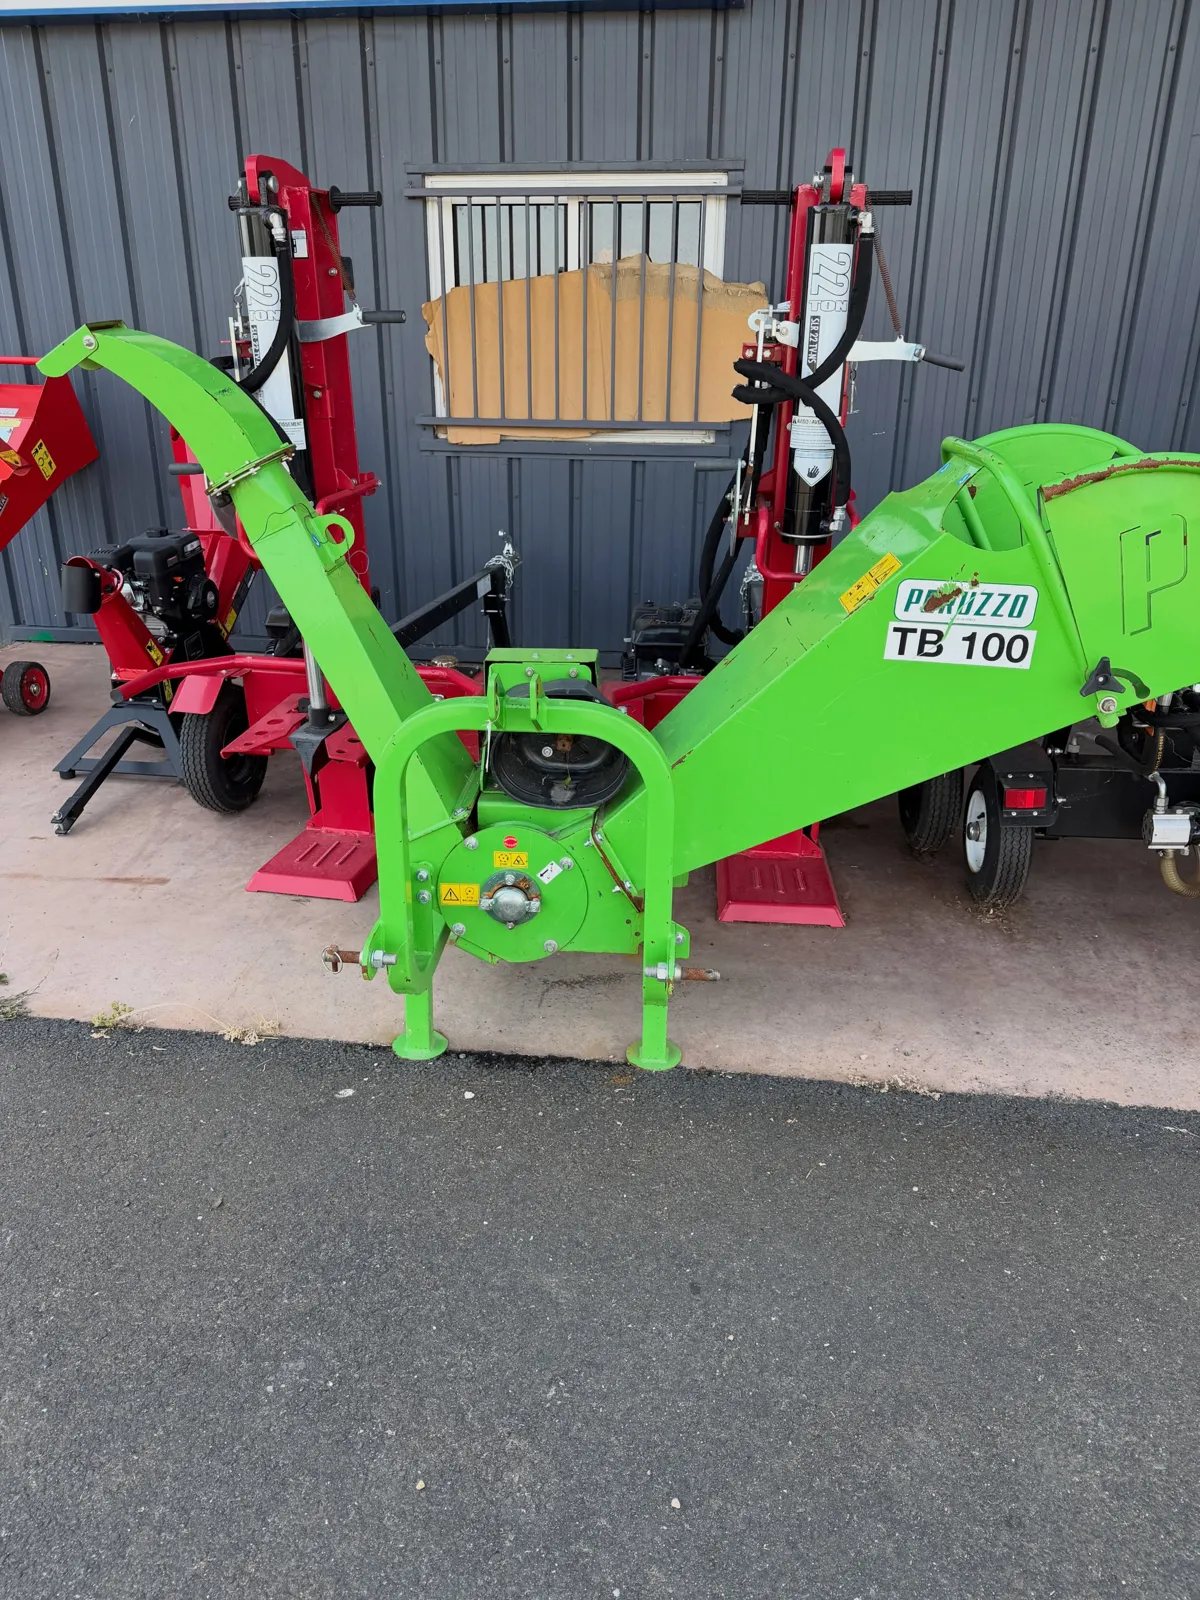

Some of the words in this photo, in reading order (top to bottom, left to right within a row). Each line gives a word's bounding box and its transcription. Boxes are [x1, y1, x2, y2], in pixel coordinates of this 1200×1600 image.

[809, 251, 852, 297] 22
[243, 264, 280, 307] 22
[808, 299, 849, 313] TON
[248, 309, 281, 322] TON
[810, 317, 820, 331] SLR
[809, 332, 819, 343] 22
[807, 343, 818, 364] TV-NS
[892, 626, 944, 658] TB
[961, 631, 1030, 664] 100
